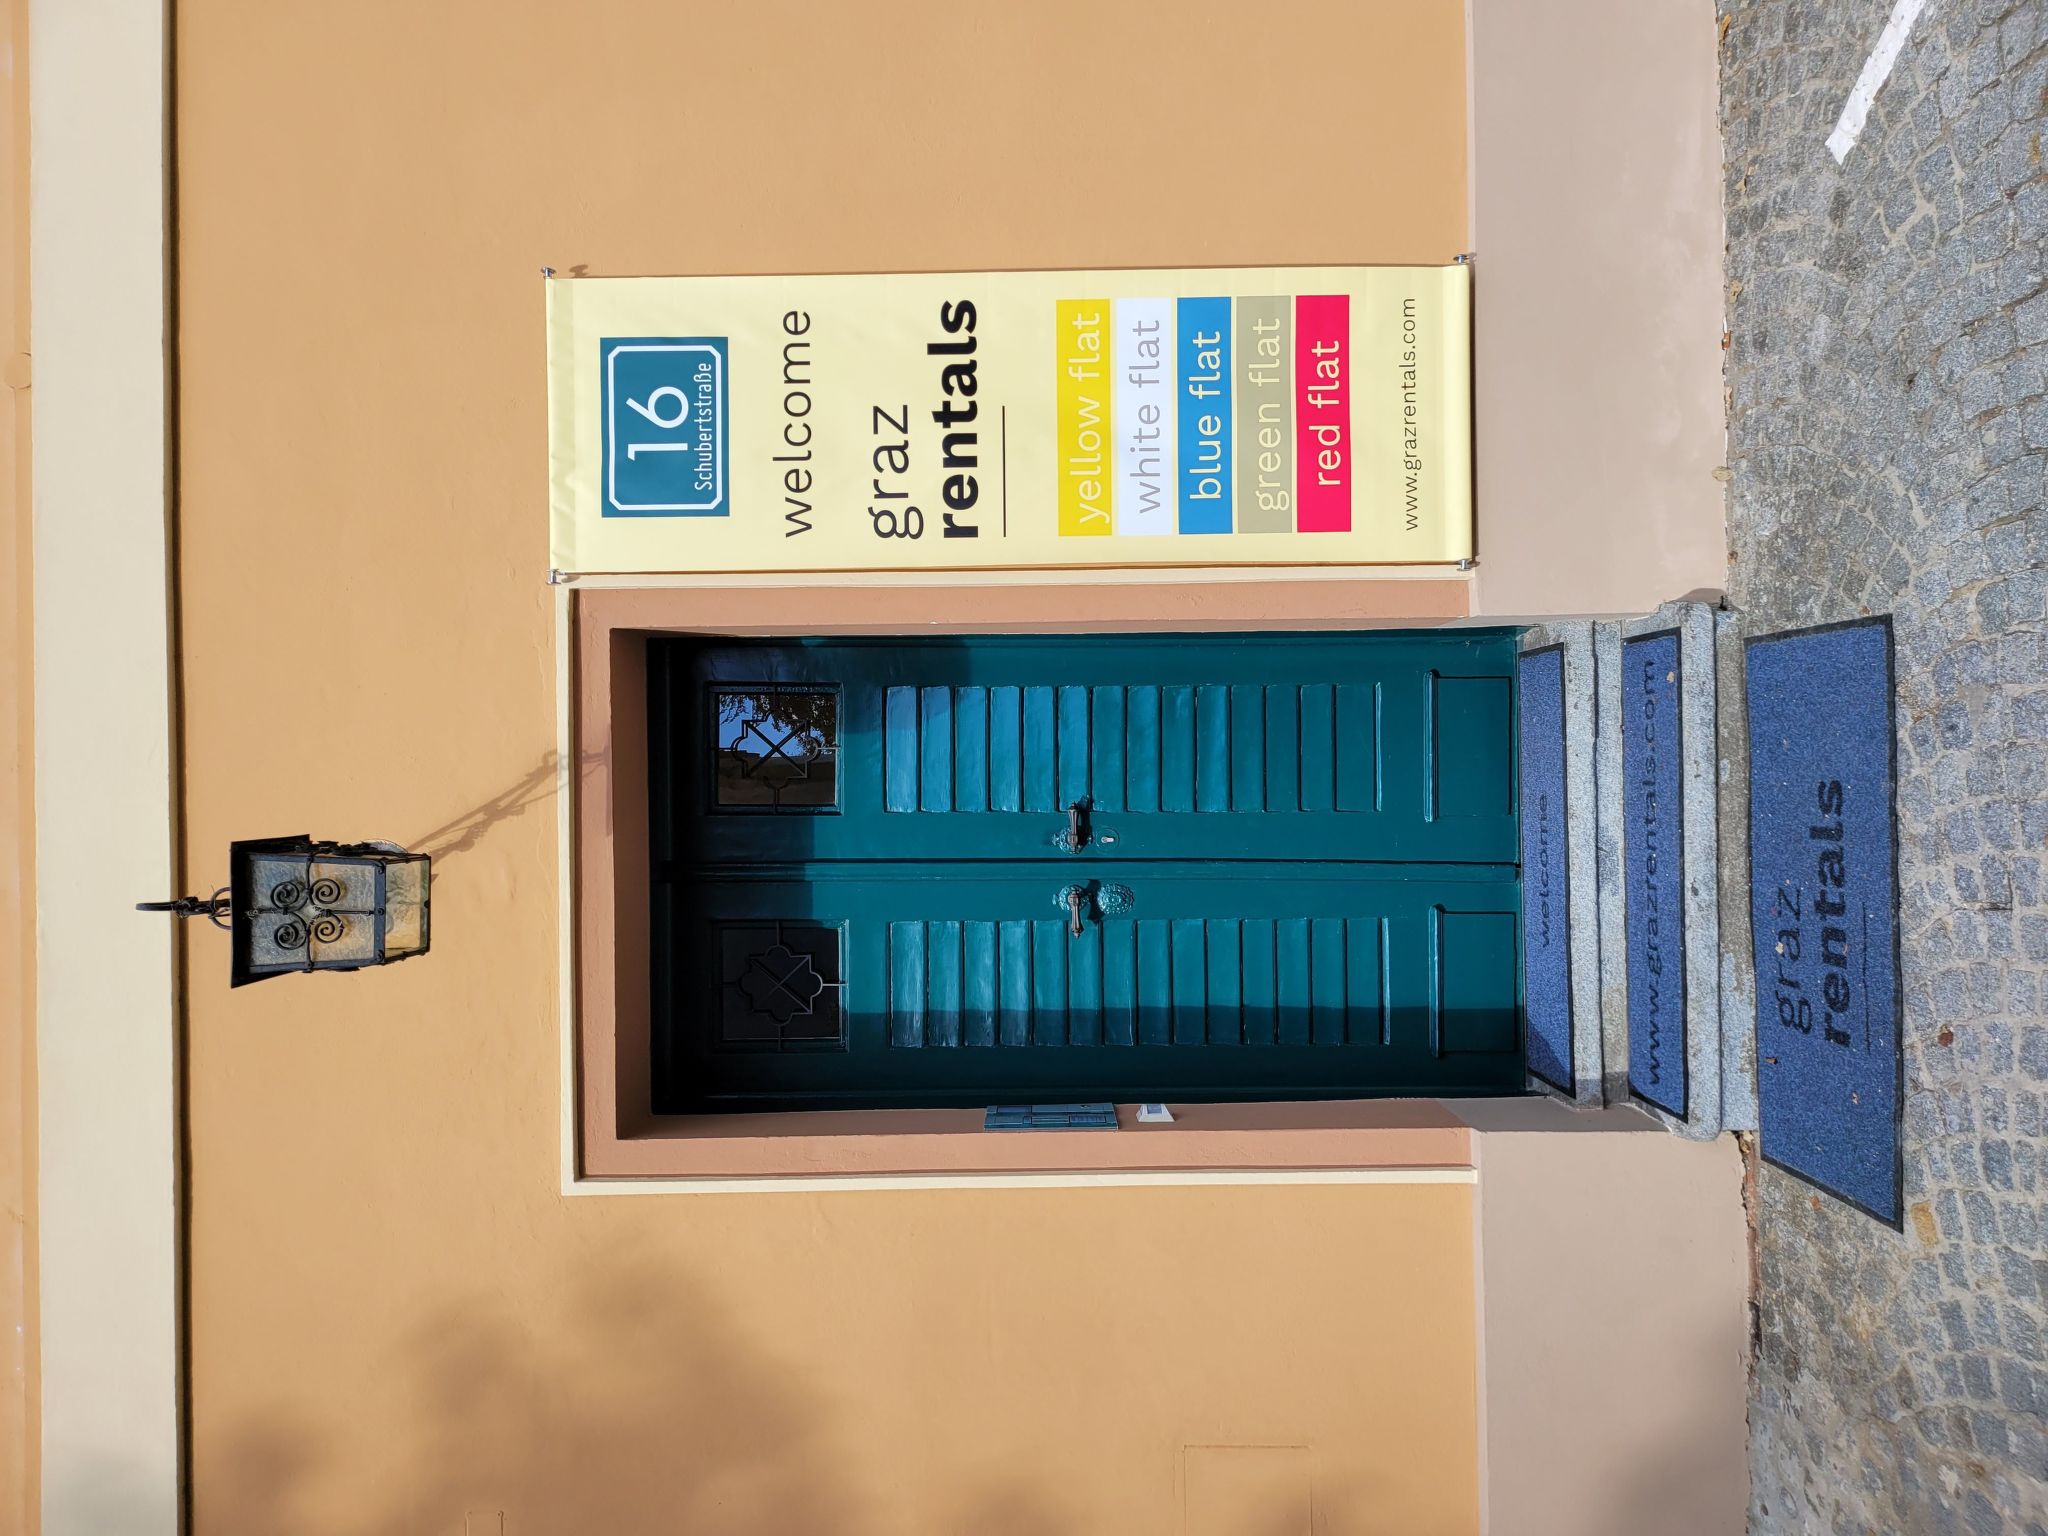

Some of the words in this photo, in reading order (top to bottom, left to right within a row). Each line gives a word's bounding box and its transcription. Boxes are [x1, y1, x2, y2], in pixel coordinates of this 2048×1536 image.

[1069, 313, 1100, 382] flat
[1129, 320, 1160, 388] flat
[1188, 331, 1221, 400] flat
[1249, 318, 1280, 387] flat
[1308, 340, 1340, 409] flat
[625, 386, 689, 461] 16
[693, 363, 713, 491] Schubertstraße
[772, 310, 812, 538] welcome
[867, 404, 924, 540] graz
[927, 299, 979, 538] rentals
[1070, 396, 1110, 524] yellow
[1129, 404, 1161, 514] white
[1189, 415, 1221, 500] blue
[1255, 403, 1290, 511] green
[1309, 425, 1341, 486] red
[1398, 297, 1422, 531] www.grazrentals.com
[1535, 793, 1551, 949] welcome
[1641, 658, 1663, 1087] www.grazrentals.com
[1810, 778, 1852, 1049] rentals
[1772, 886, 1813, 1035] graz
